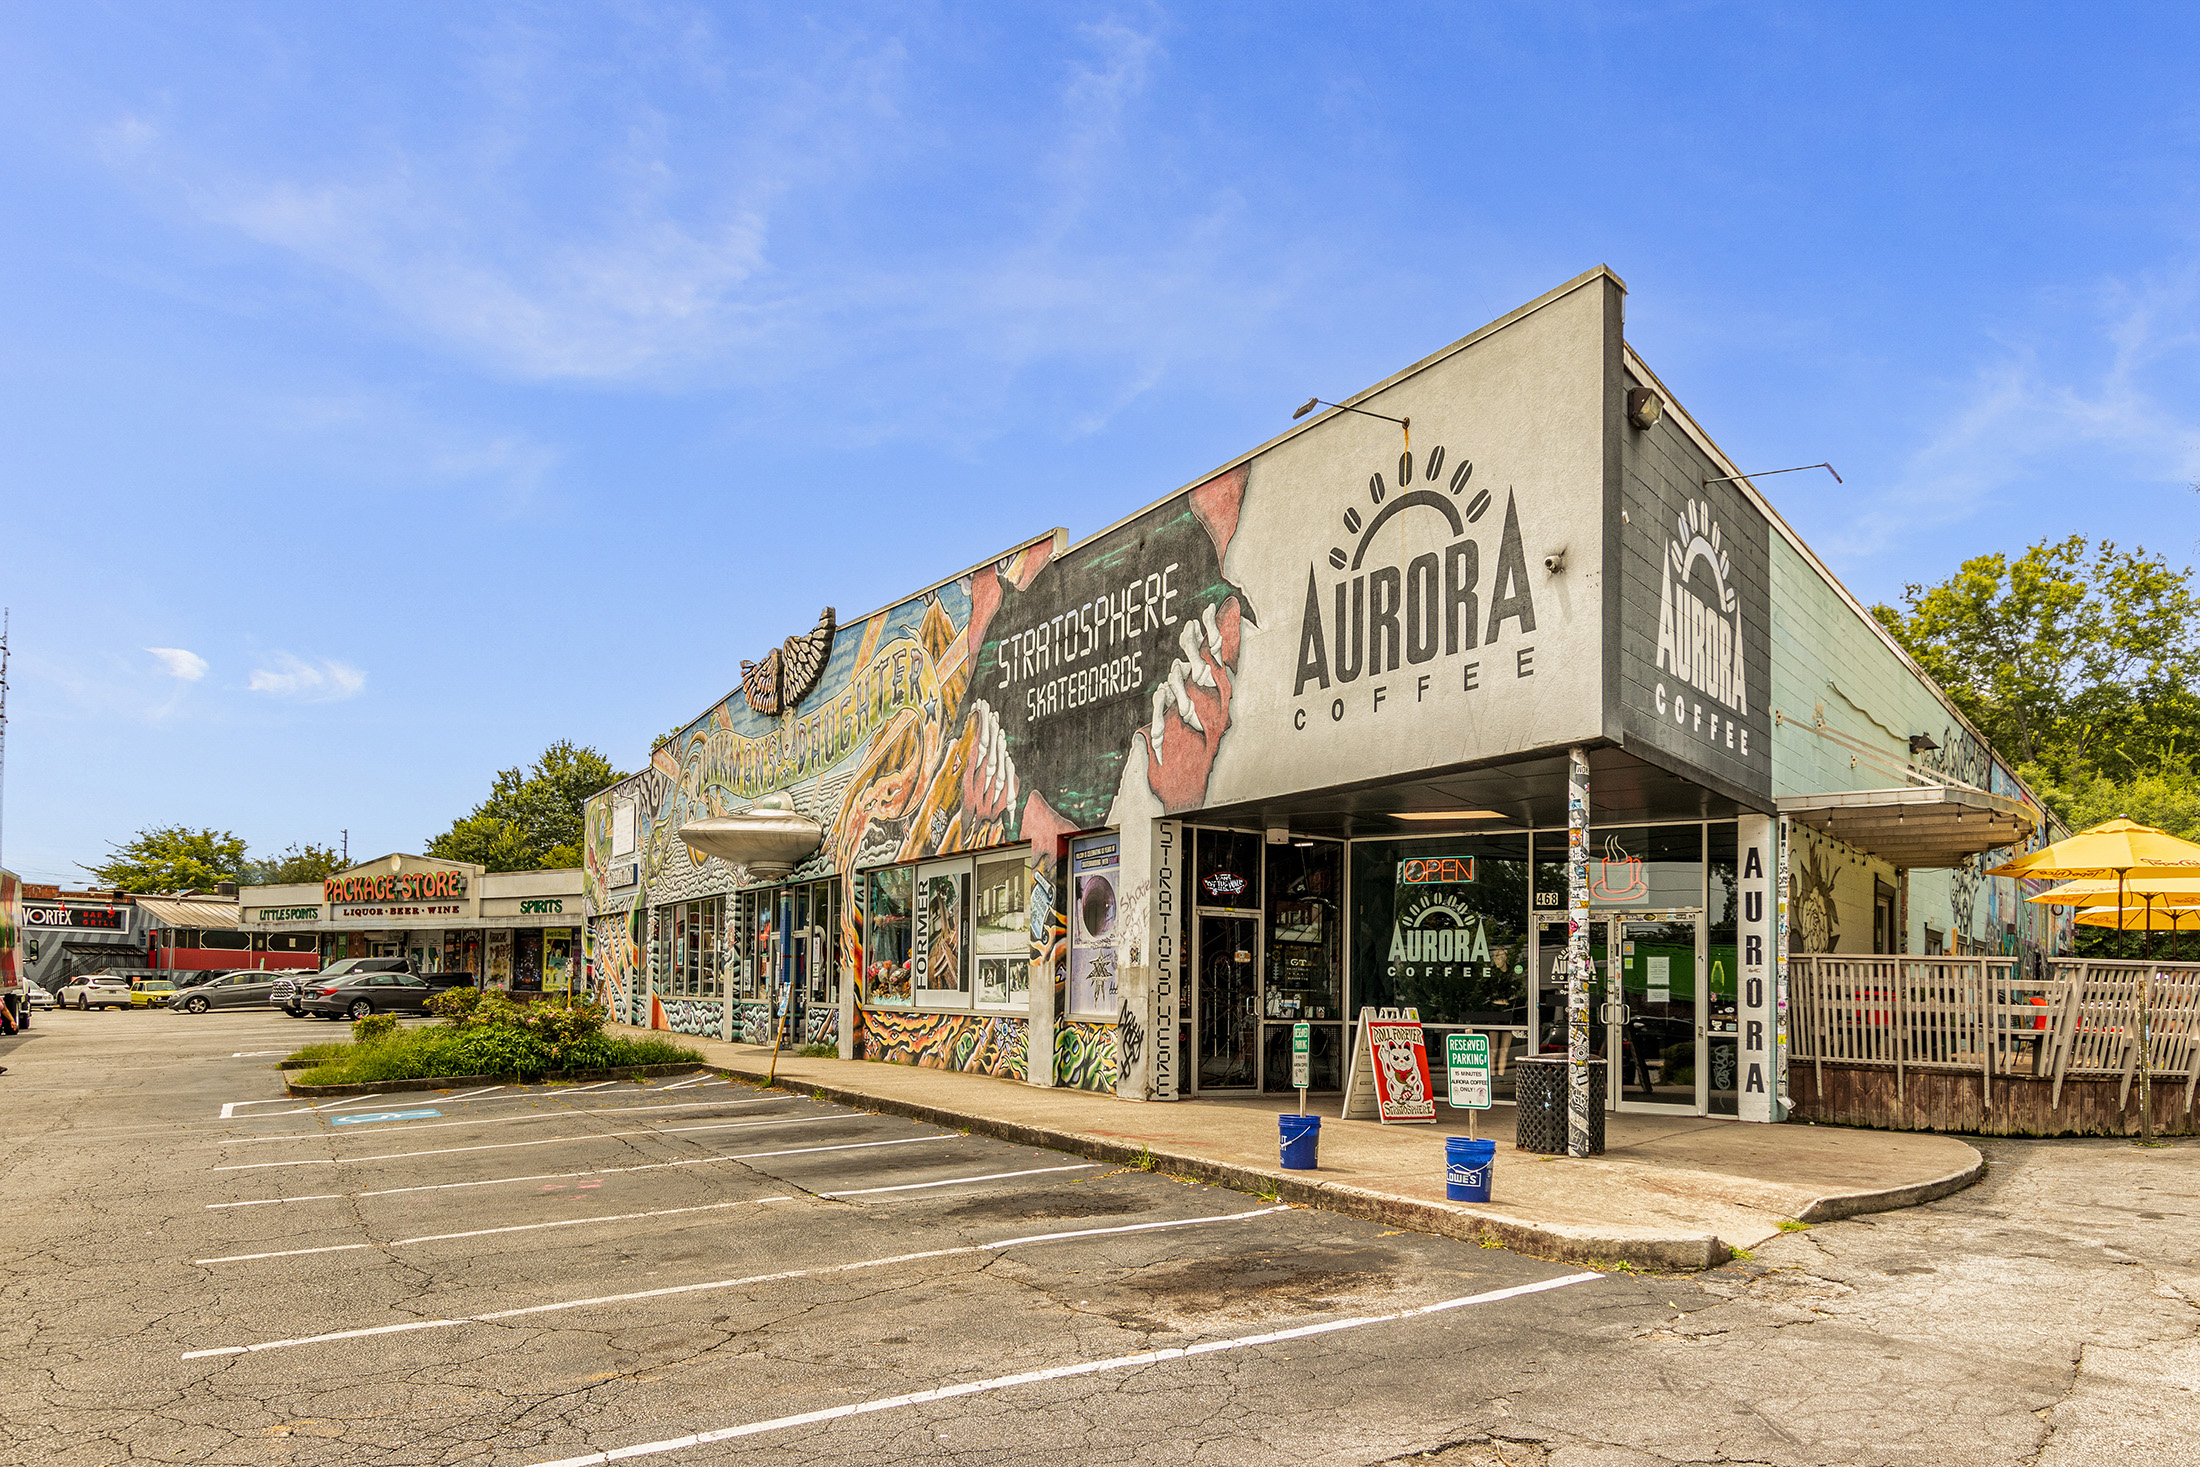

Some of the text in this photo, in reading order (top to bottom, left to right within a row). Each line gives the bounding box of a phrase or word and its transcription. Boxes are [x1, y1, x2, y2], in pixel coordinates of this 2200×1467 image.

[1292, 484, 1537, 697] AURORA
[998, 562, 1179, 689] STRATOSPHERE
[1655, 538, 1748, 716] AURORA
[1027, 650, 1143, 722] SKATEBOARDS
[1294, 646, 1536, 731] COFFEE
[797, 647, 923, 776] DAUGHTER
[1655, 682, 1748, 756] COFFEE
[324, 870, 462, 902] PACKAGE STORE
[1404, 858, 1474, 883] OPEN
[259, 907, 318, 920] LITTLE 5 POINTS
[343, 905, 460, 916] LIQUOR BEER WINE
[520, 899, 563, 914] SPIRITS
[1537, 893, 1558, 905] 468
[22, 907, 72, 928] VORTEX
[83, 911, 102, 919] BAR
[82, 919, 115, 927] GRILL
[917, 880, 928, 990] FORMER
[1388, 919, 1491, 962] AURORA
[1157, 822, 1173, 1097] STRATOSPHERE
[1387, 966, 1491, 978] COFFEE
[1743, 847, 1765, 1094] AURORA
[1373, 1027, 1424, 1044] ROLL FOREVER
[1449, 1039, 1486, 1051] RESERVED
[1384, 1102, 1433, 1116] STRATOSPHERE
